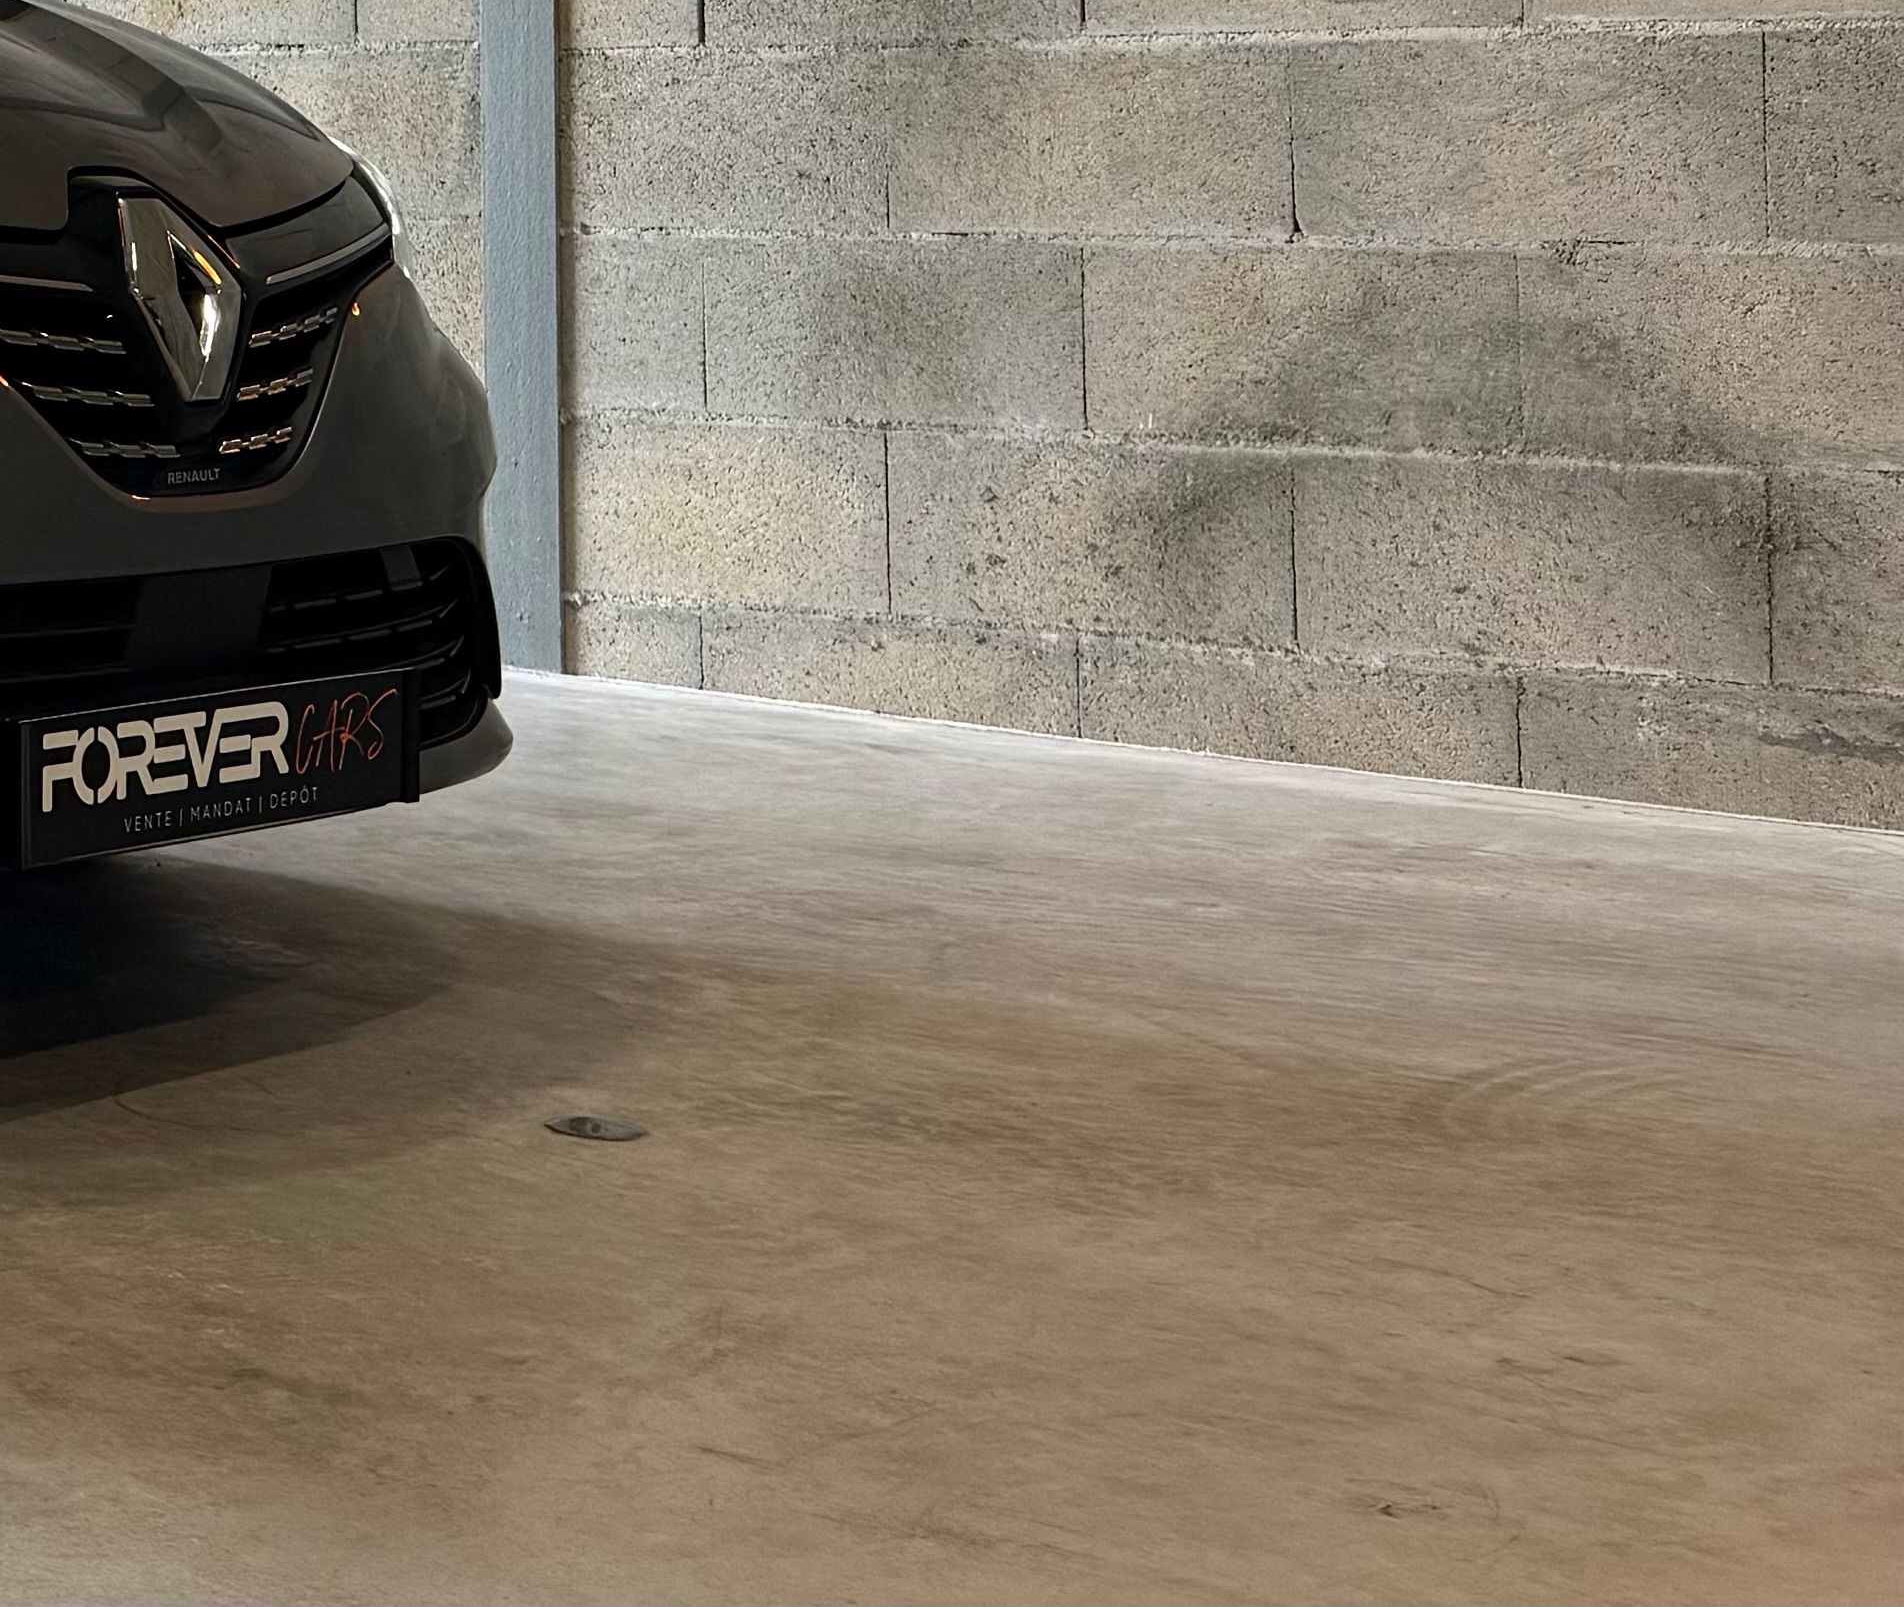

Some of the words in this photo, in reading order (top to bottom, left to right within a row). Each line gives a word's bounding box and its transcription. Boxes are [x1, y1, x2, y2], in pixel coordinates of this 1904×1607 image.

[167, 467, 221, 485] RENAULT
[42, 701, 289, 813] FOREVER
[295, 688, 398, 775] CARS
[124, 809, 173, 834] VENTE
[189, 797, 253, 823] MANDAT
[269, 785, 320, 811] DEPÔT
